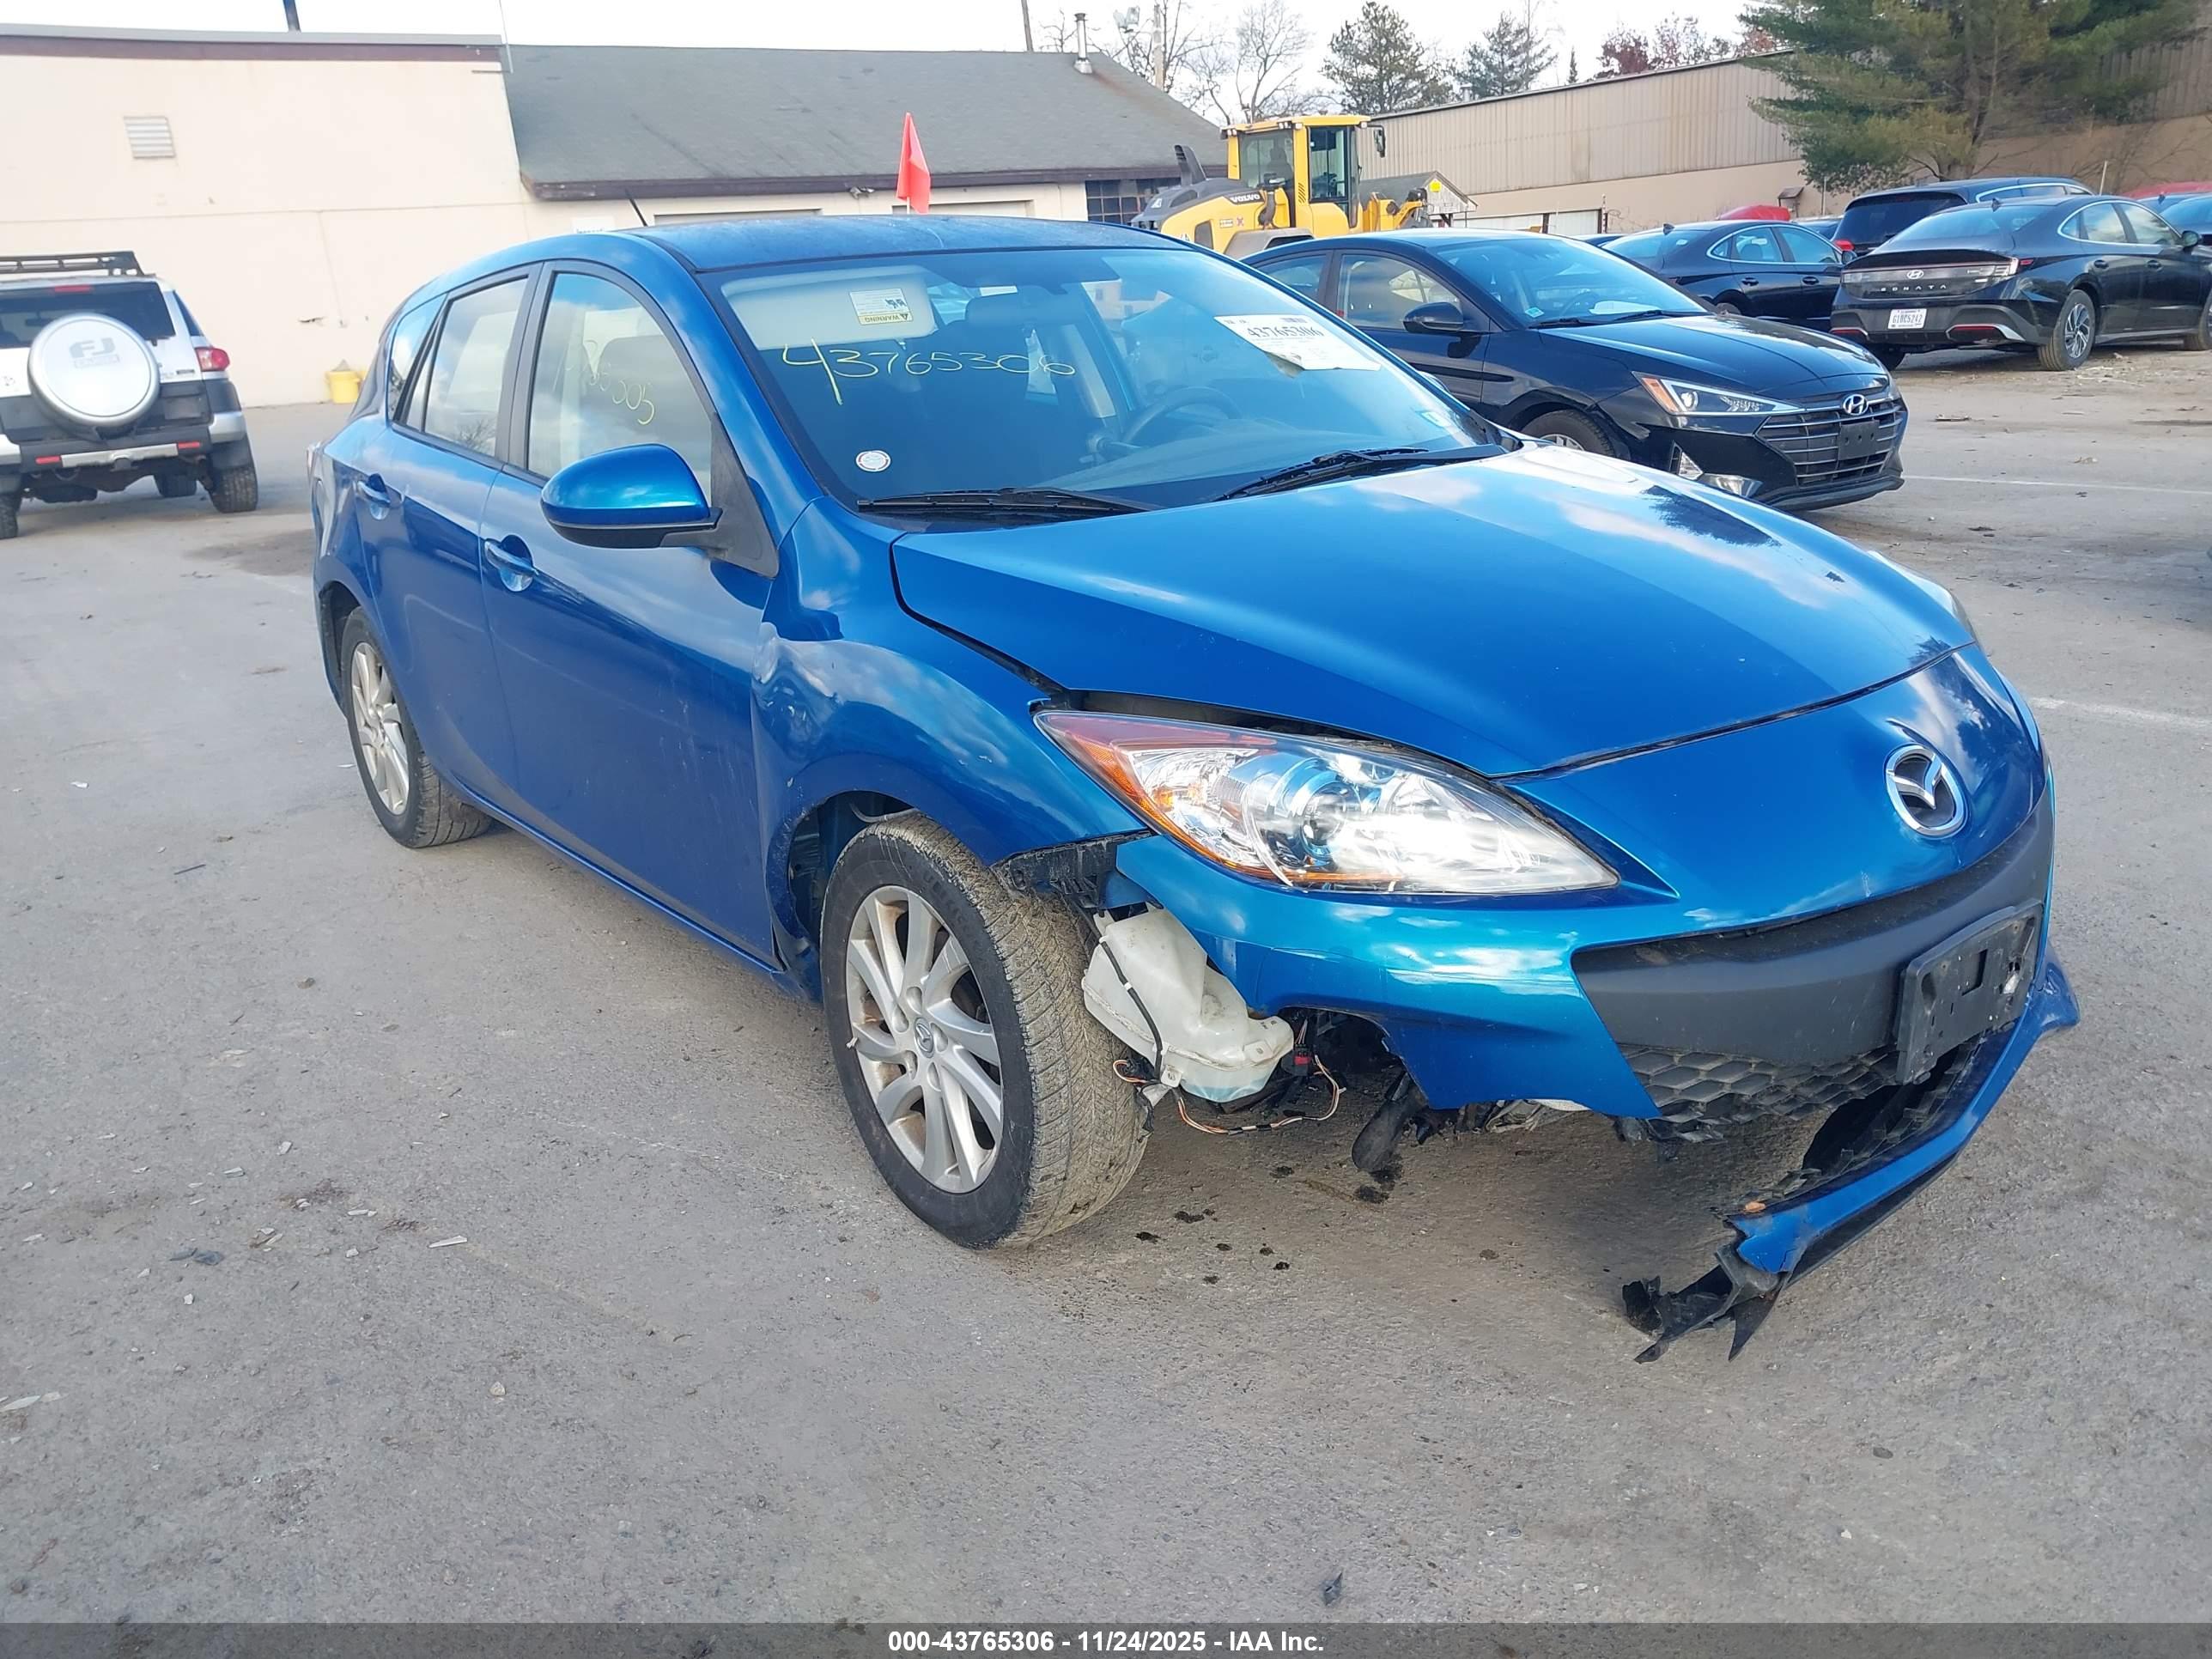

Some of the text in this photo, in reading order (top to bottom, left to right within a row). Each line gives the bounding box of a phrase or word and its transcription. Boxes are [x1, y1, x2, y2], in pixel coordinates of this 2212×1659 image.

[1230, 193, 1261, 203] VOLVO
[1247, 325, 1325, 337] 43765306
[70, 337, 116, 359] FJ
[782, 337, 1076, 405] 43765306
